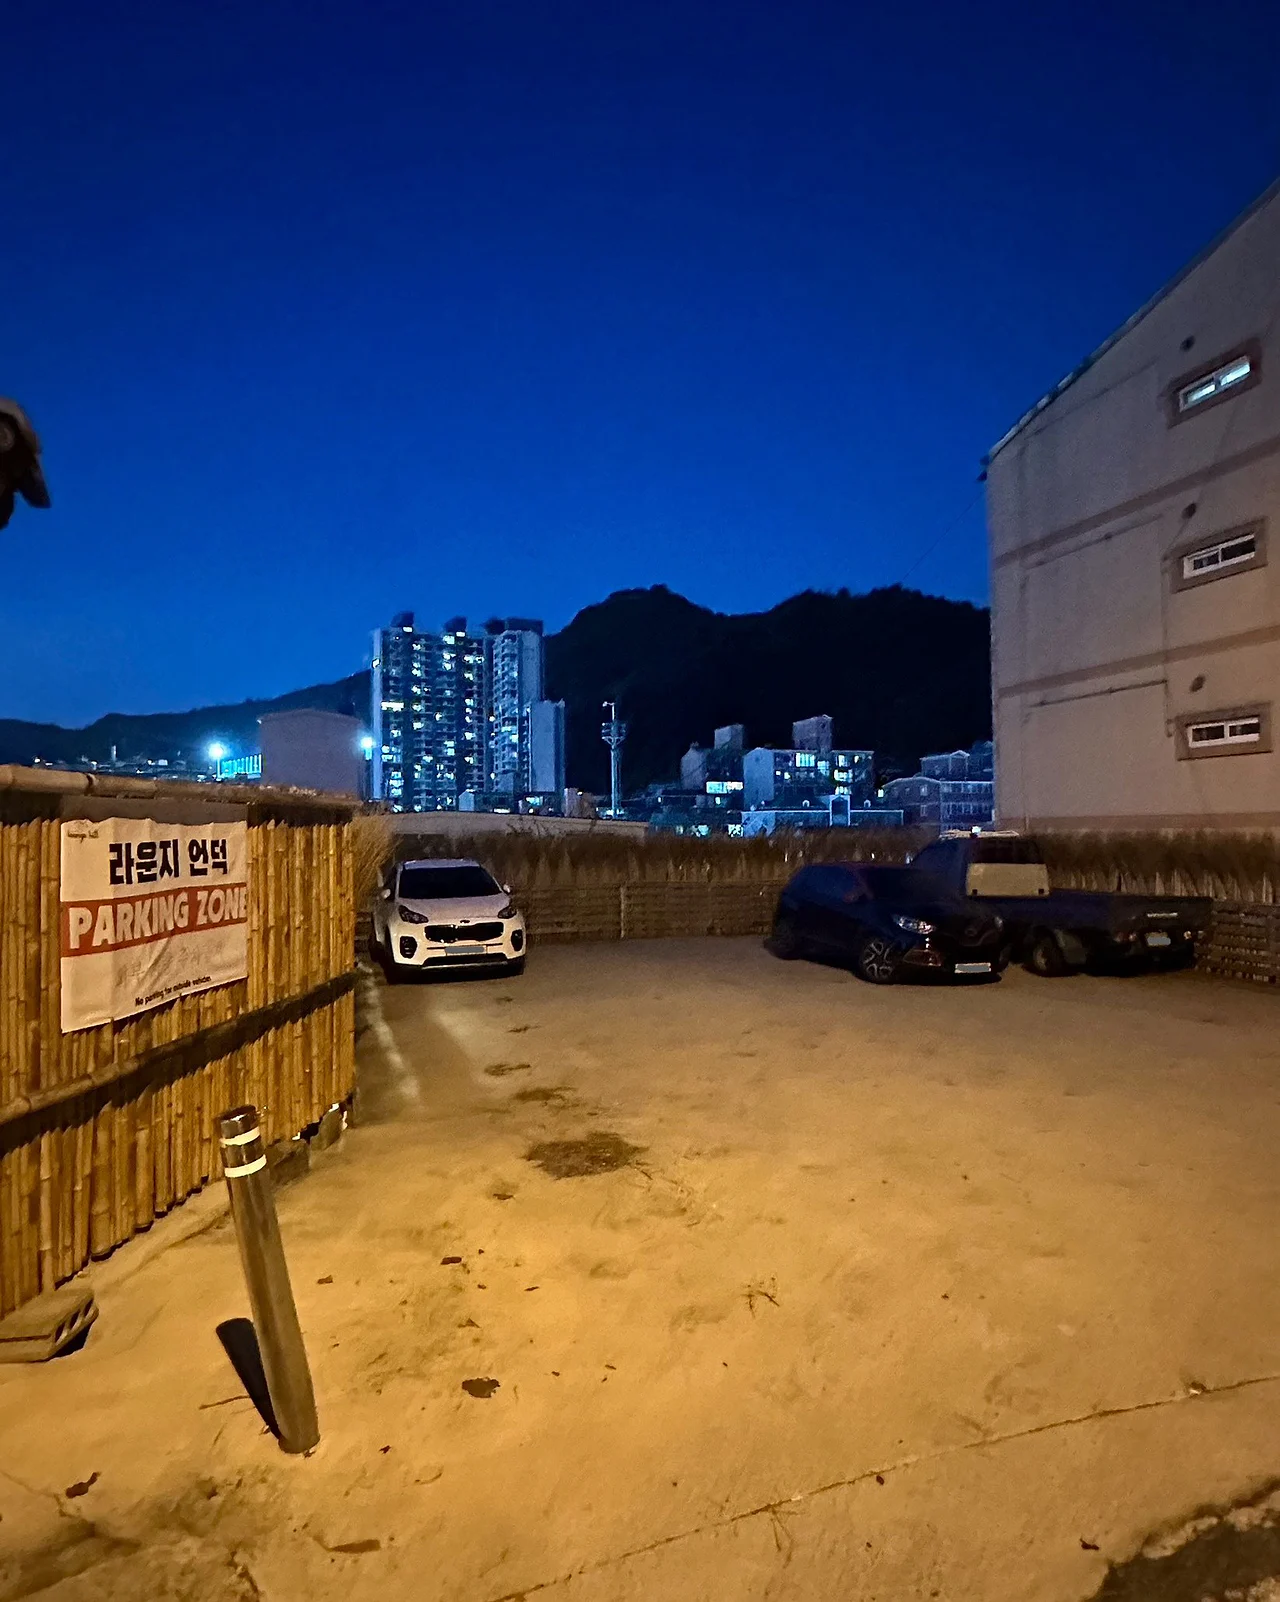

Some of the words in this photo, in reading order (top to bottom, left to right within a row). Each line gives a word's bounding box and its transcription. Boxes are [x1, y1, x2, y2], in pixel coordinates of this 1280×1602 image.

[109, 839, 180, 885] 라운지
[188, 838, 228, 876] 언덕
[68, 891, 189, 950] PARKING
[196, 886, 247, 926] ZONE
